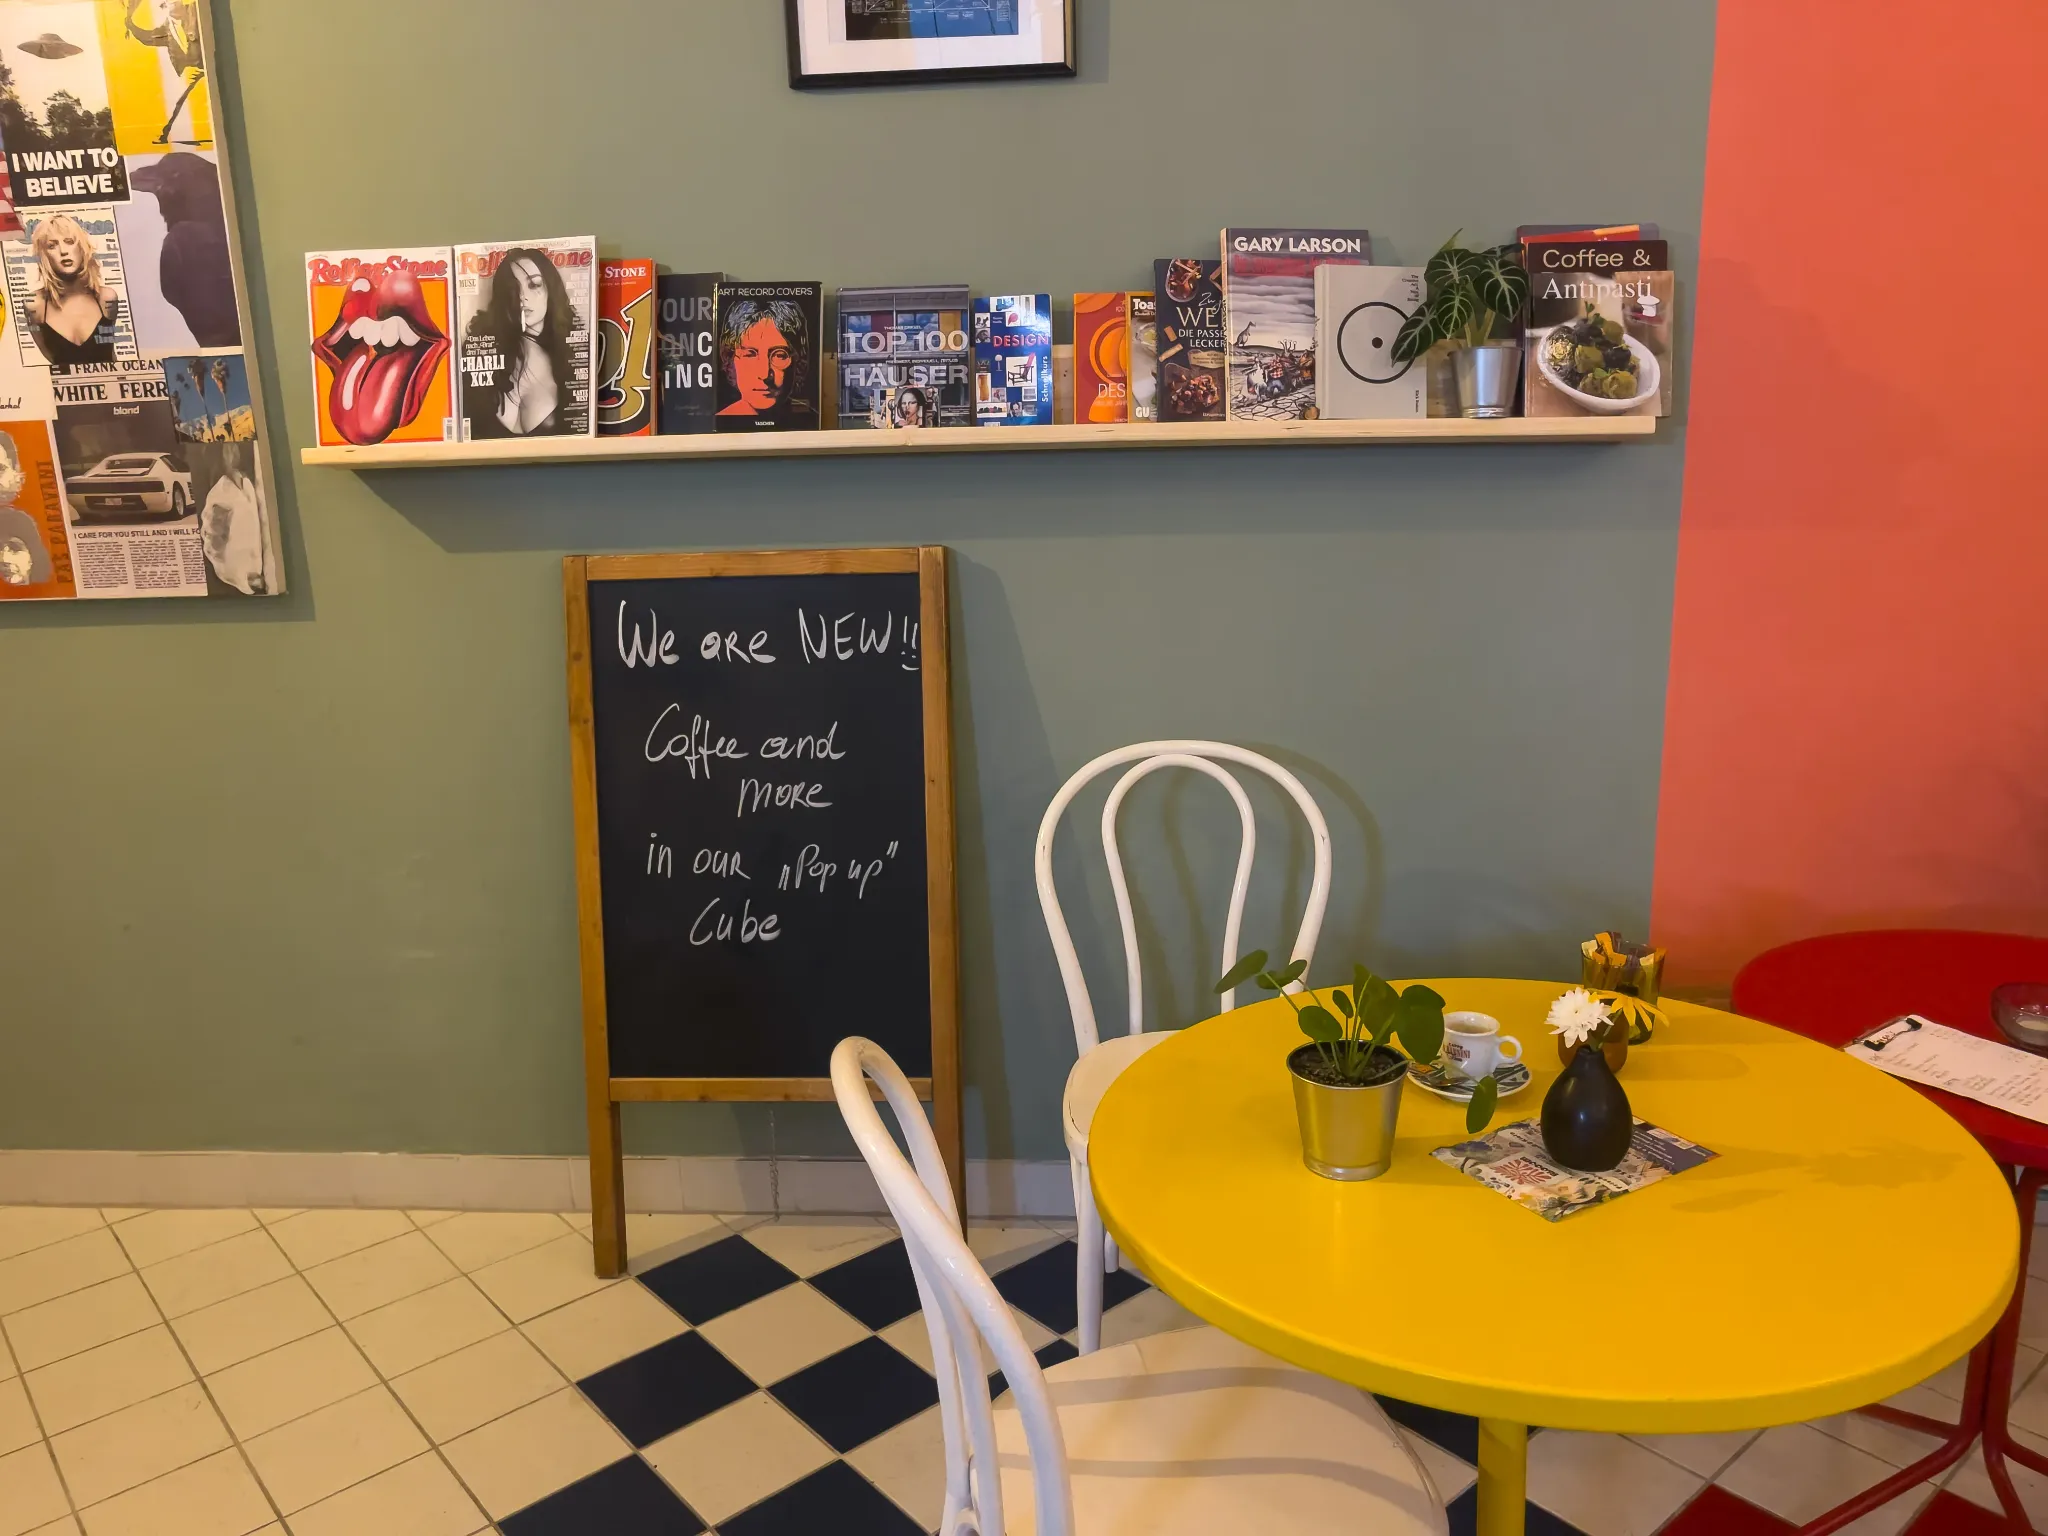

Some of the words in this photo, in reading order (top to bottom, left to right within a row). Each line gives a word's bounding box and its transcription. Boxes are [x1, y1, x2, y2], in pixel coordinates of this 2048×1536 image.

[12, 152, 21, 173] I
[24, 149, 84, 172] WANT
[87, 146, 119, 168] TO
[26, 173, 114, 198] BELIEVE
[1233, 236, 1284, 252] GARY
[1288, 237, 1361, 253] LARSON
[1542, 248, 1624, 268] Coffee
[1632, 249, 1652, 267] &
[717, 288, 735, 297] ART
[737, 287, 775, 297] RECORD
[776, 287, 813, 296] COVERS
[1541, 275, 1652, 303] Antipasti
[843, 331, 908, 354] TOP
[913, 330, 969, 352] 100
[992, 334, 1050, 348] DESIGN
[1178, 329, 1194, 338] DIE
[75, 361, 118, 374] FRANK
[122, 359, 164, 372] OCEAN
[460, 354, 505, 372] CHARLI
[470, 371, 495, 388] XCX
[844, 362, 969, 387] HÄUSER
[1135, 406, 1151, 418] GU
[78, 531, 98, 539] CARE
[617, 599, 681, 669] We
[699, 629, 778, 665] are
[644, 702, 751, 780] Coffee
[760, 719, 848, 761] and
[736, 777, 834, 819] more
[646, 832, 673, 880] in
[692, 849, 753, 881] our
[688, 896, 782, 947] Cube
